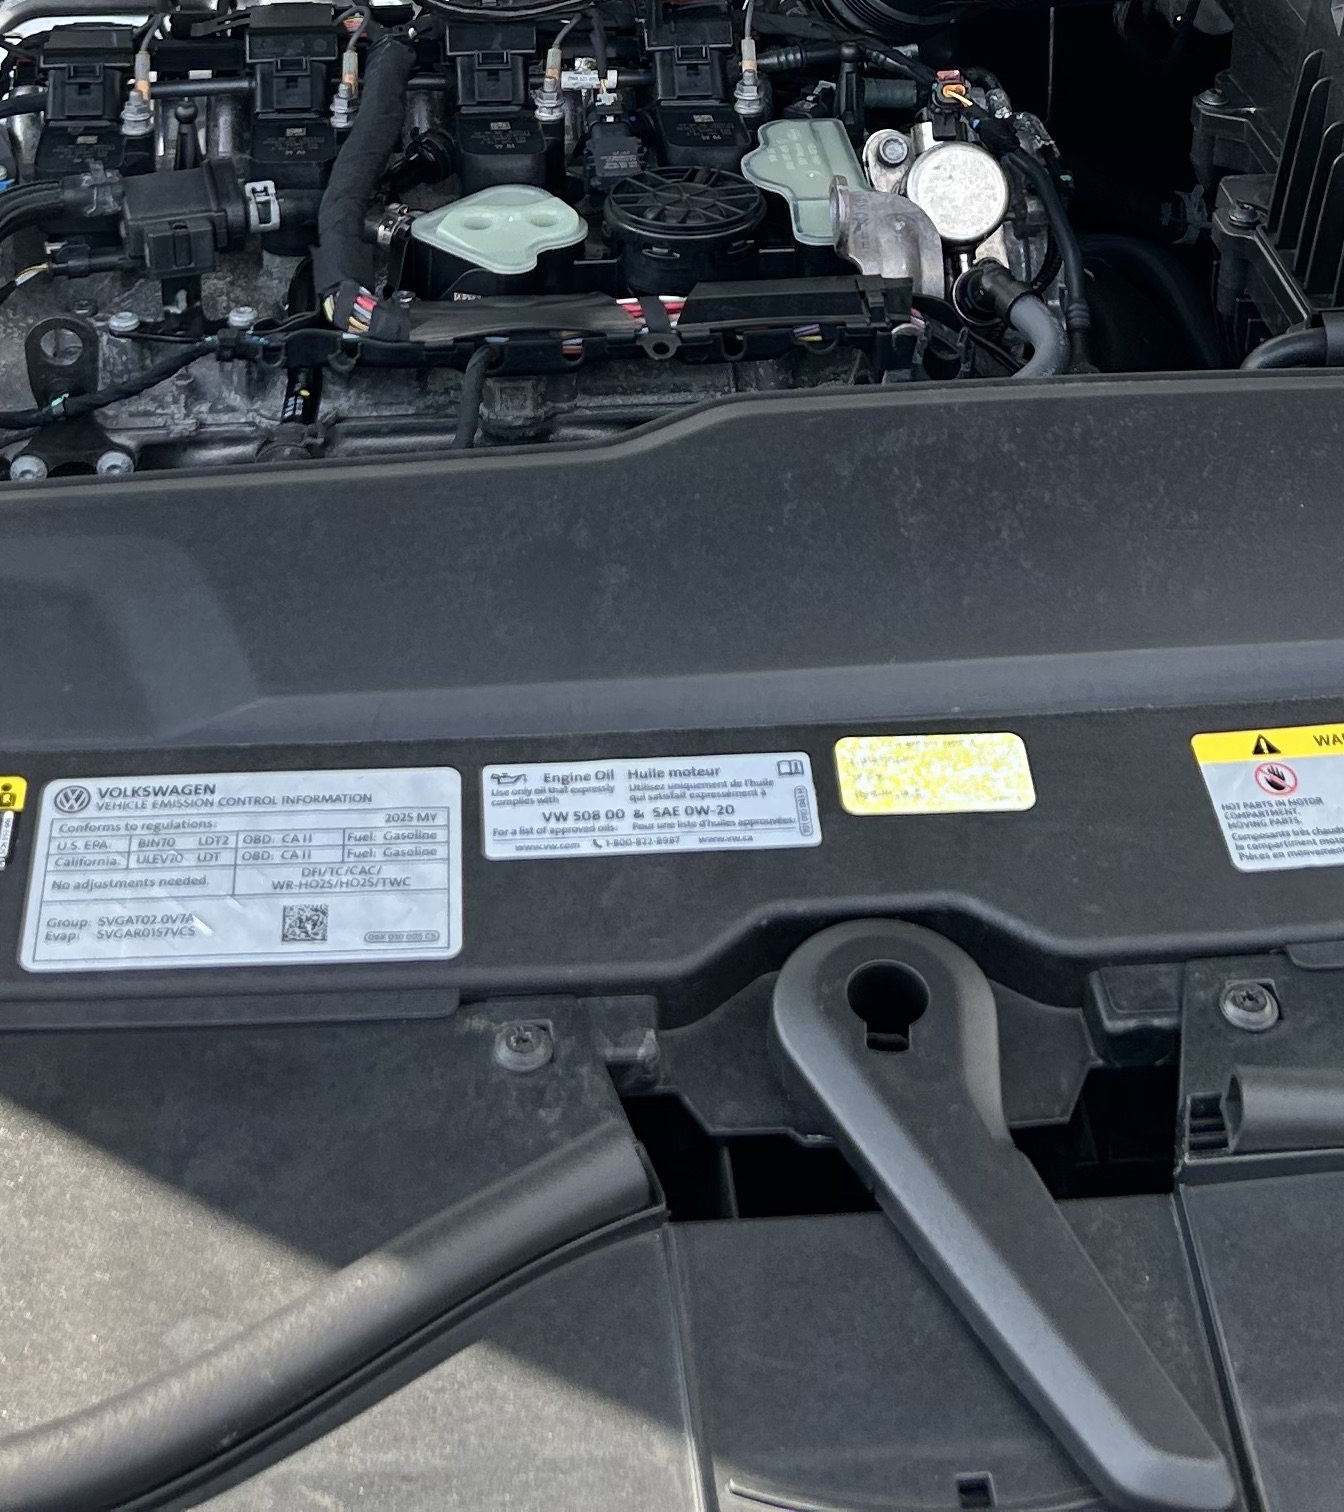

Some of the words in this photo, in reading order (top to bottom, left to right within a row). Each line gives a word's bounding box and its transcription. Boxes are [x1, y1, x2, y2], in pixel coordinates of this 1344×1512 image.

[543, 772, 591, 786] Engine
[595, 769, 614, 782] Oil
[627, 768, 665, 781] Huile
[668, 766, 720, 779] moteur
[98, 784, 217, 798] VOLKSWAGEN
[96, 799, 147, 812] VEHICLE
[152, 798, 214, 809] EMISSION
[218, 794, 278, 808] CONTROL
[282, 793, 372, 805] INFORMATION
[385, 813, 414, 823] 2025
[417, 812, 438, 822] MY
[542, 810, 571, 823] VW
[573, 810, 602, 821] 508
[606, 809, 625, 820] 00
[634, 809, 645, 818] &
[652, 805, 680, 817] SAE
[684, 804, 735, 817] 0W-20
[59, 822, 121, 833] Conforms
[125, 821, 138, 831] to
[141, 820, 217, 834] regulations:
[198, 836, 229, 846] LDT2
[347, 832, 377, 842] Fuel:
[383, 830, 438, 841] Gasoline
[197, 852, 221, 862] LDT
[347, 848, 376, 859] Fuel:
[383, 847, 438, 857] Gasoline
[51, 880, 70, 890] No
[73, 878, 156, 893] adjustments
[159, 875, 210, 887] needed.
[47, 917, 91, 929] Group:
